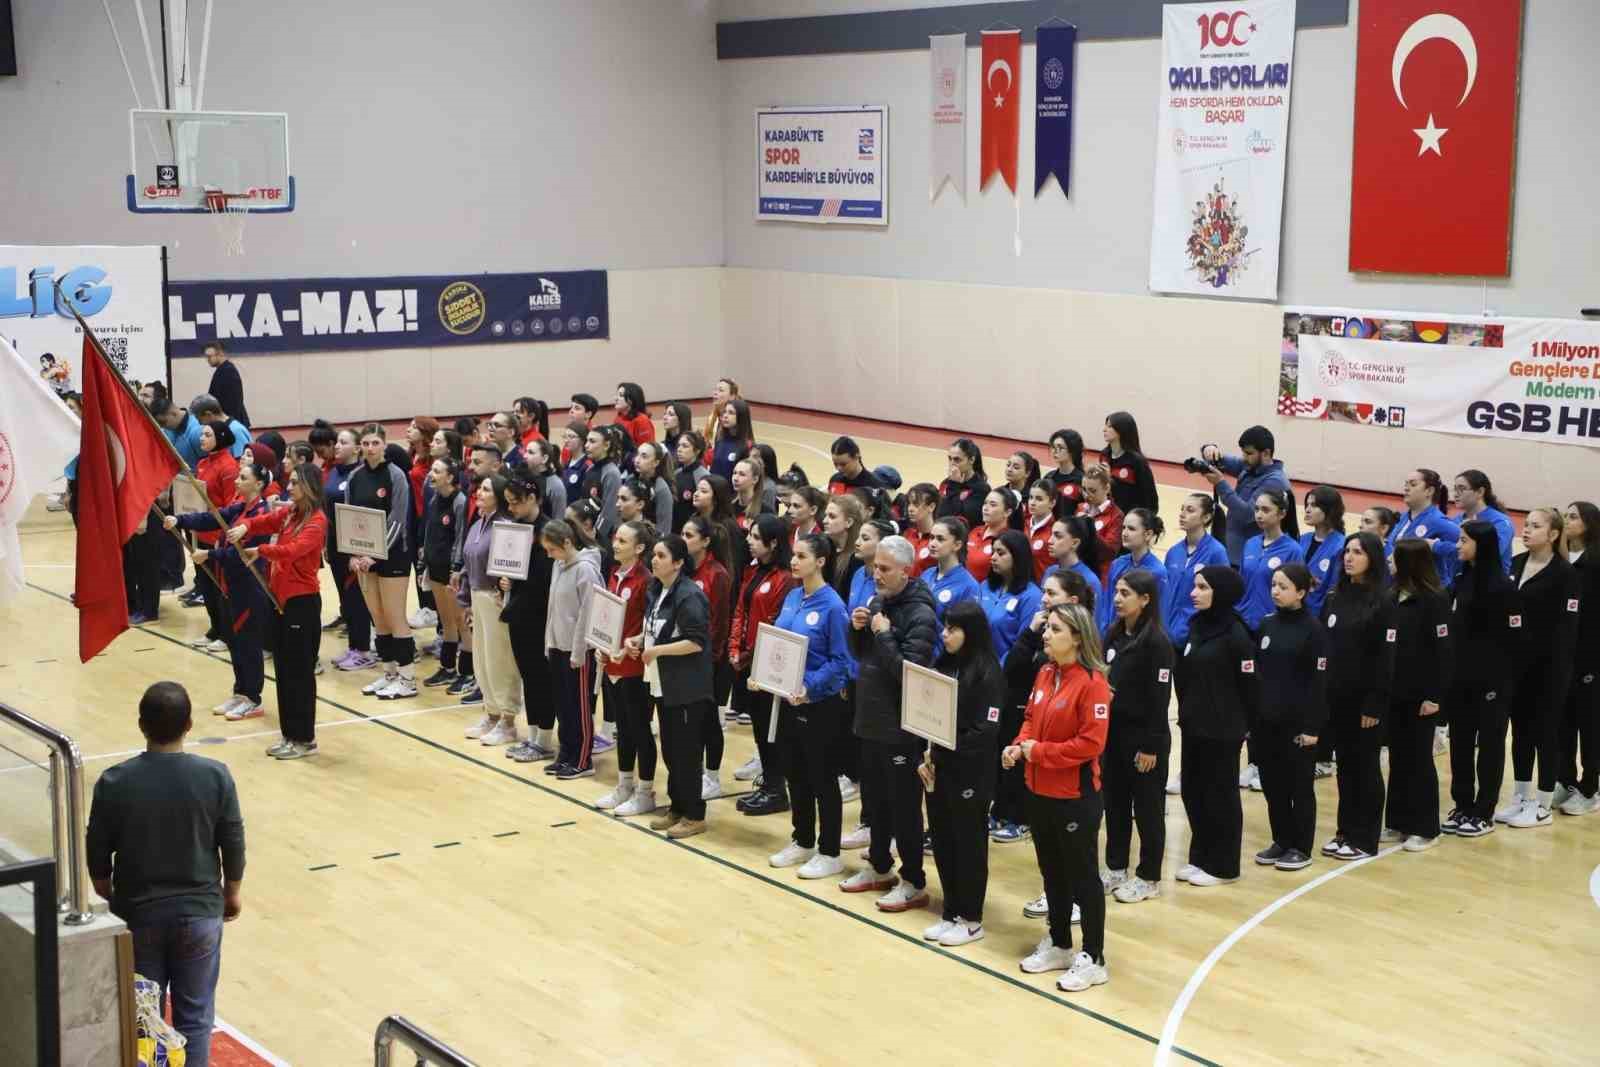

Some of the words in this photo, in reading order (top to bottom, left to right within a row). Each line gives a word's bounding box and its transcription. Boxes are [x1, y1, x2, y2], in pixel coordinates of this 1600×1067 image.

[1168, 66, 1208, 91] OKUL
[1210, 62, 1289, 91] SPORLARI
[1169, 97, 1188, 108] HEM
[1189, 96, 1224, 108] SPORDA
[1225, 95, 1246, 107] HEM
[1247, 95, 1283, 107] OKULDA
[1205, 109, 1245, 125] BAŞARI
[764, 126, 824, 143] KARABÜK'TE
[765, 148, 800, 165] SPOR
[765, 167, 826, 184] KARDEMİR'LE
[828, 168, 874, 185] BÜYÜYOR
[259, 188, 282, 199] TBF
[529, 294, 561, 306] KADES
[75, 325, 118, 334] Bvuru
[1532, 341, 1538, 357] 1
[1541, 342, 1600, 361] Milyon
[1396, 366, 1405, 374] VE
[1509, 361, 1590, 382] Gençlere
[1525, 381, 1595, 399] Modern
[1467, 400, 1551, 433] GSB
